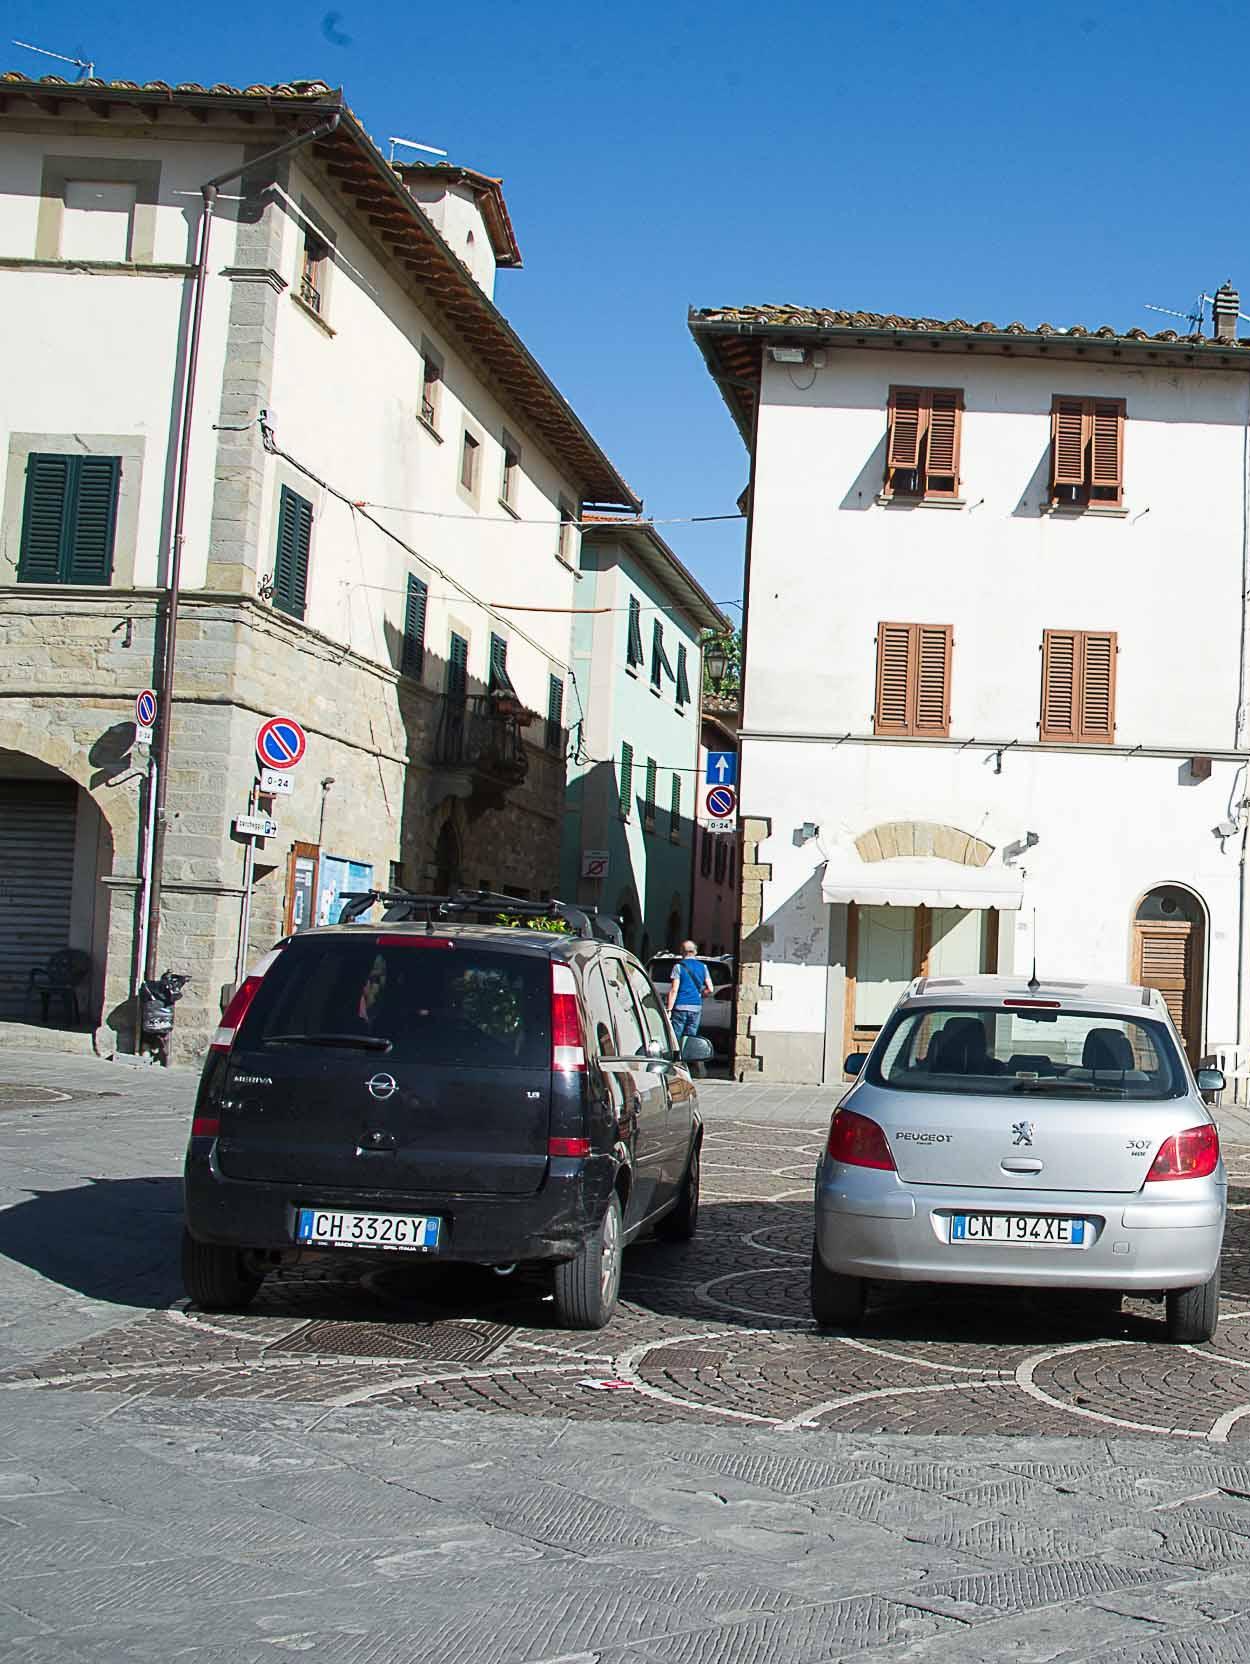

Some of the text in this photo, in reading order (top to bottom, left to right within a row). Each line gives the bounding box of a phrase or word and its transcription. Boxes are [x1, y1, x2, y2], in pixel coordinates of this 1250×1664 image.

[267, 776, 289, 787] 0-24
[711, 822, 728, 830] 0-24
[895, 1132, 953, 1143] PEUGEOT
[1125, 1140, 1152, 1150] 307
[315, 1214, 344, 1239] CH
[352, 1215, 423, 1243] 332GY
[968, 1215, 993, 1237] CN
[1005, 1216, 1069, 1240] 194XE
